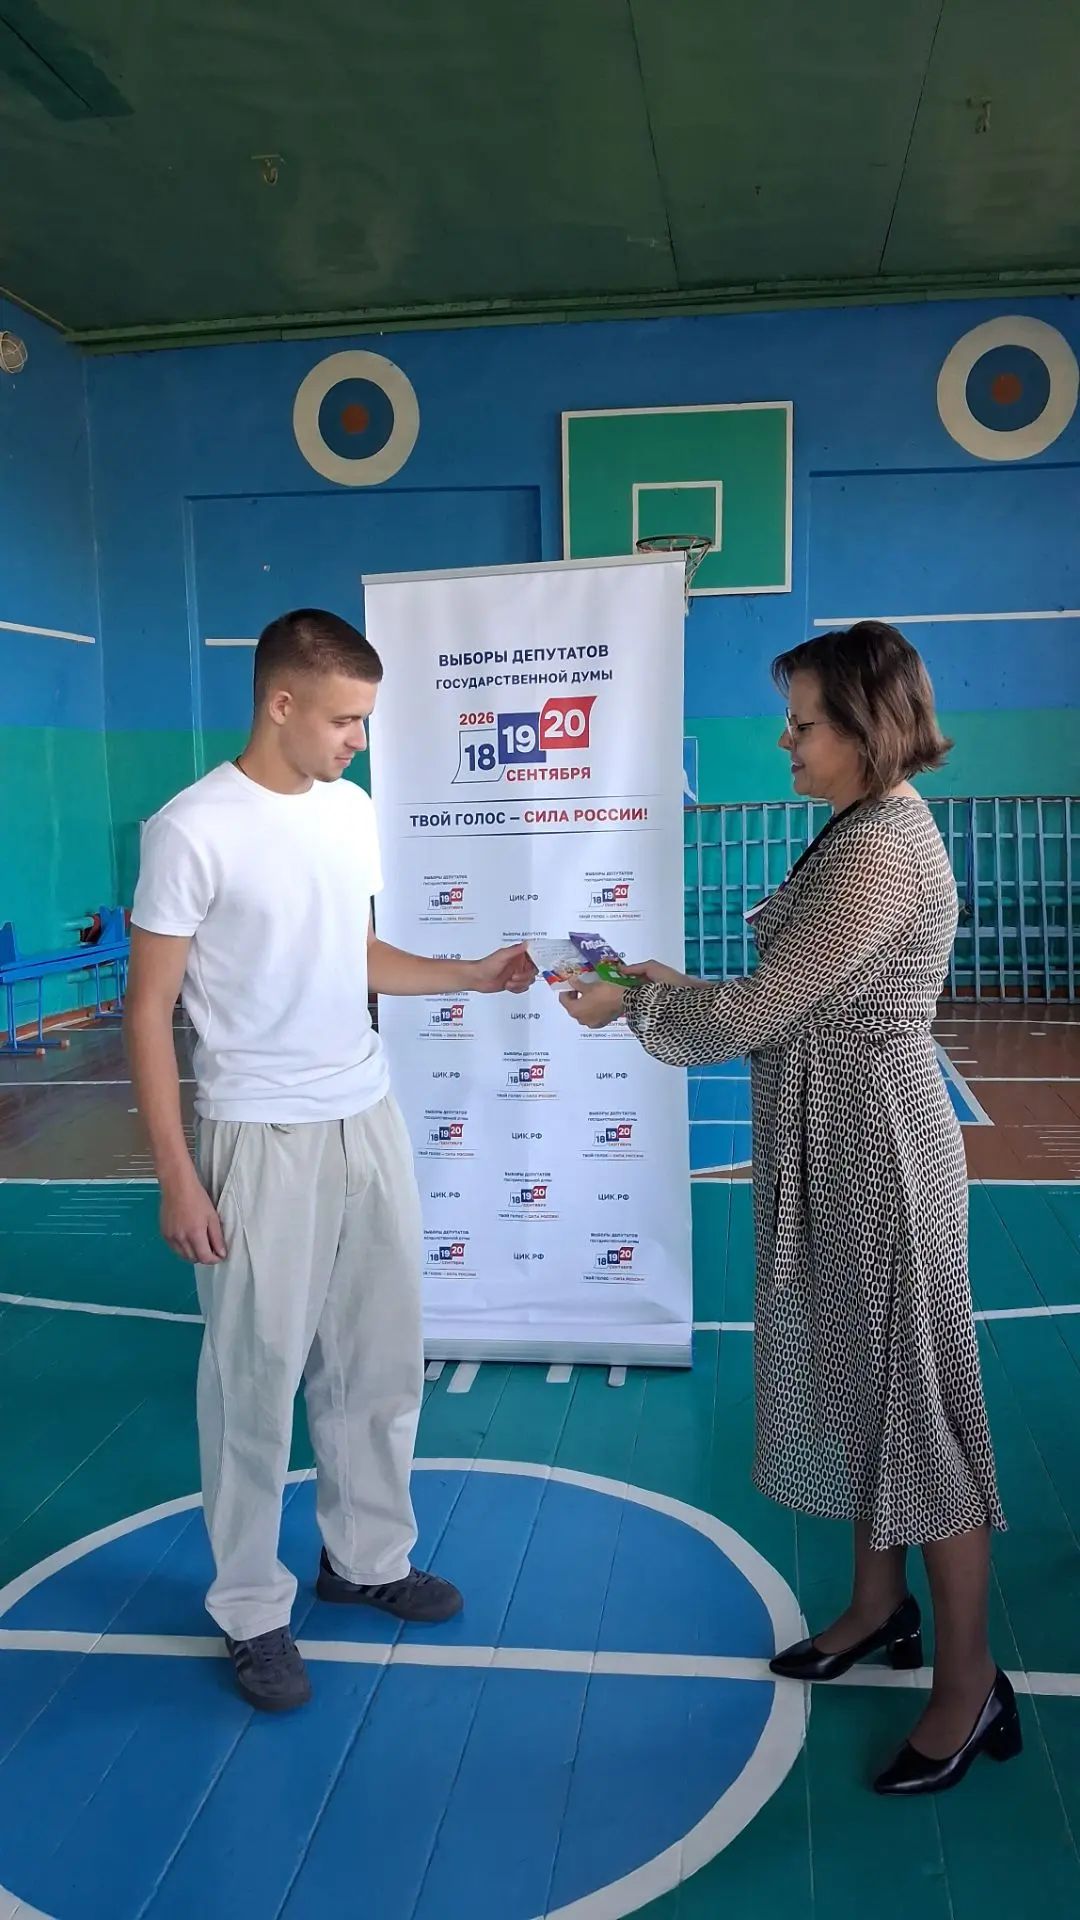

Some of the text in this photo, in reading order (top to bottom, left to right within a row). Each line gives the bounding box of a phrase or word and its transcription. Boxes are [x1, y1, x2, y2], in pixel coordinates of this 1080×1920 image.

[439, 644, 609, 667] ВЫБОРЫ ДЕПУТАТОВ
[436, 669, 613, 690] ГОСУДАРСТВЕННОЙ ДУМЫ
[459, 712, 495, 725] 2026
[464, 709, 586, 772] 18 19 20
[506, 767, 591, 782] СЕНТЯБРЯ
[410, 811, 451, 828] ТВОЙ
[455, 812, 506, 827] ГОЛОС
[524, 809, 569, 824] СИЛА
[574, 808, 648, 822] РОССИИ!
[441, 895, 449, 903] 19
[451, 891, 462, 899] 20
[604, 892, 613, 900] 19
[440, 1129, 449, 1137] 19
[607, 1131, 617, 1139] 19
[619, 1127, 630, 1135] 20
[522, 1192, 531, 1200] 19
[533, 1188, 545, 1196] 20
[441, 1249, 450, 1258] 19
[452, 1246, 463, 1254] 20
[609, 1253, 618, 1261] 19
[620, 1250, 631, 1258] 20
